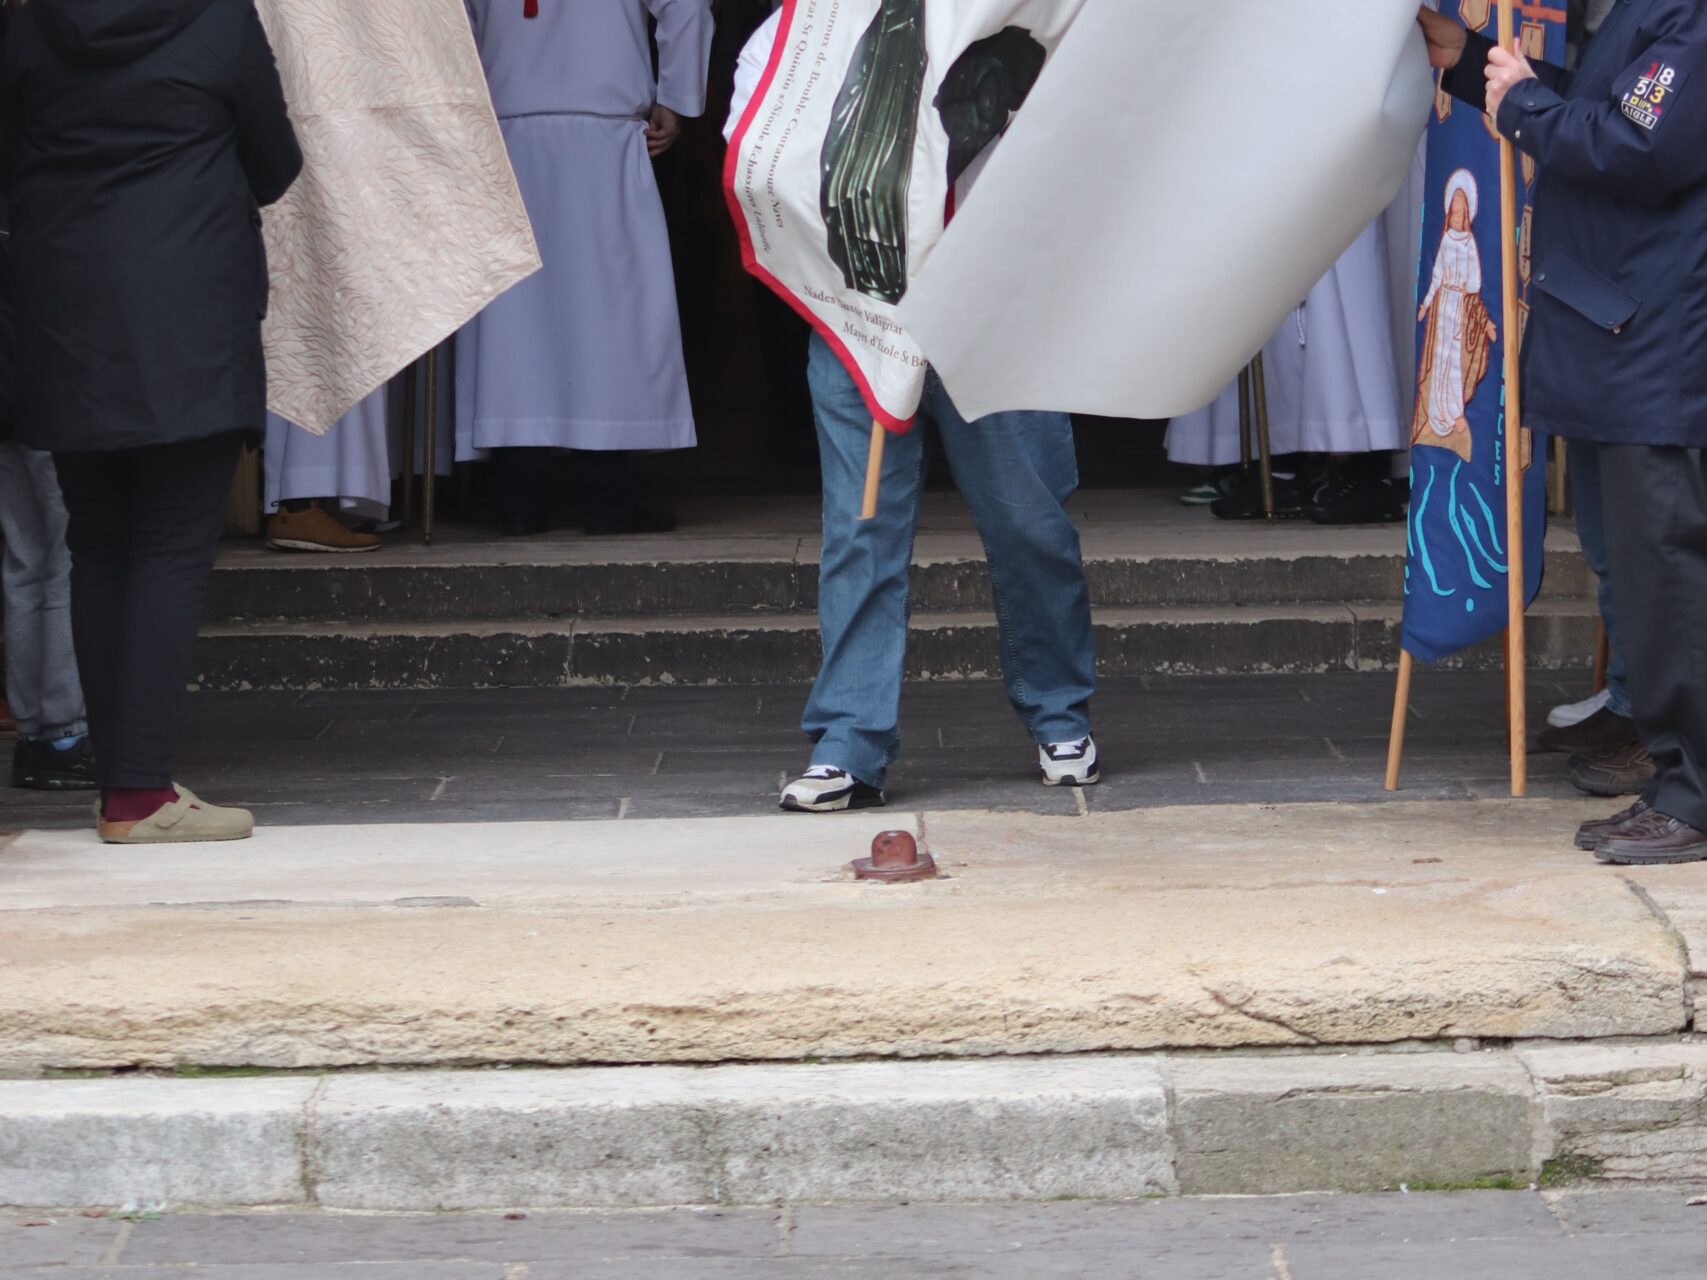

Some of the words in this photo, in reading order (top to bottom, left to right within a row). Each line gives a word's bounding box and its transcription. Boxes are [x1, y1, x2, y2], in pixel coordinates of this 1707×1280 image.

[783, 39, 808, 90] Quintin
[814, 52, 827, 67] de
[794, 70, 821, 115] Bouble
[1624, 106, 1652, 125] AIGLE
[803, 285, 835, 305] Nades
